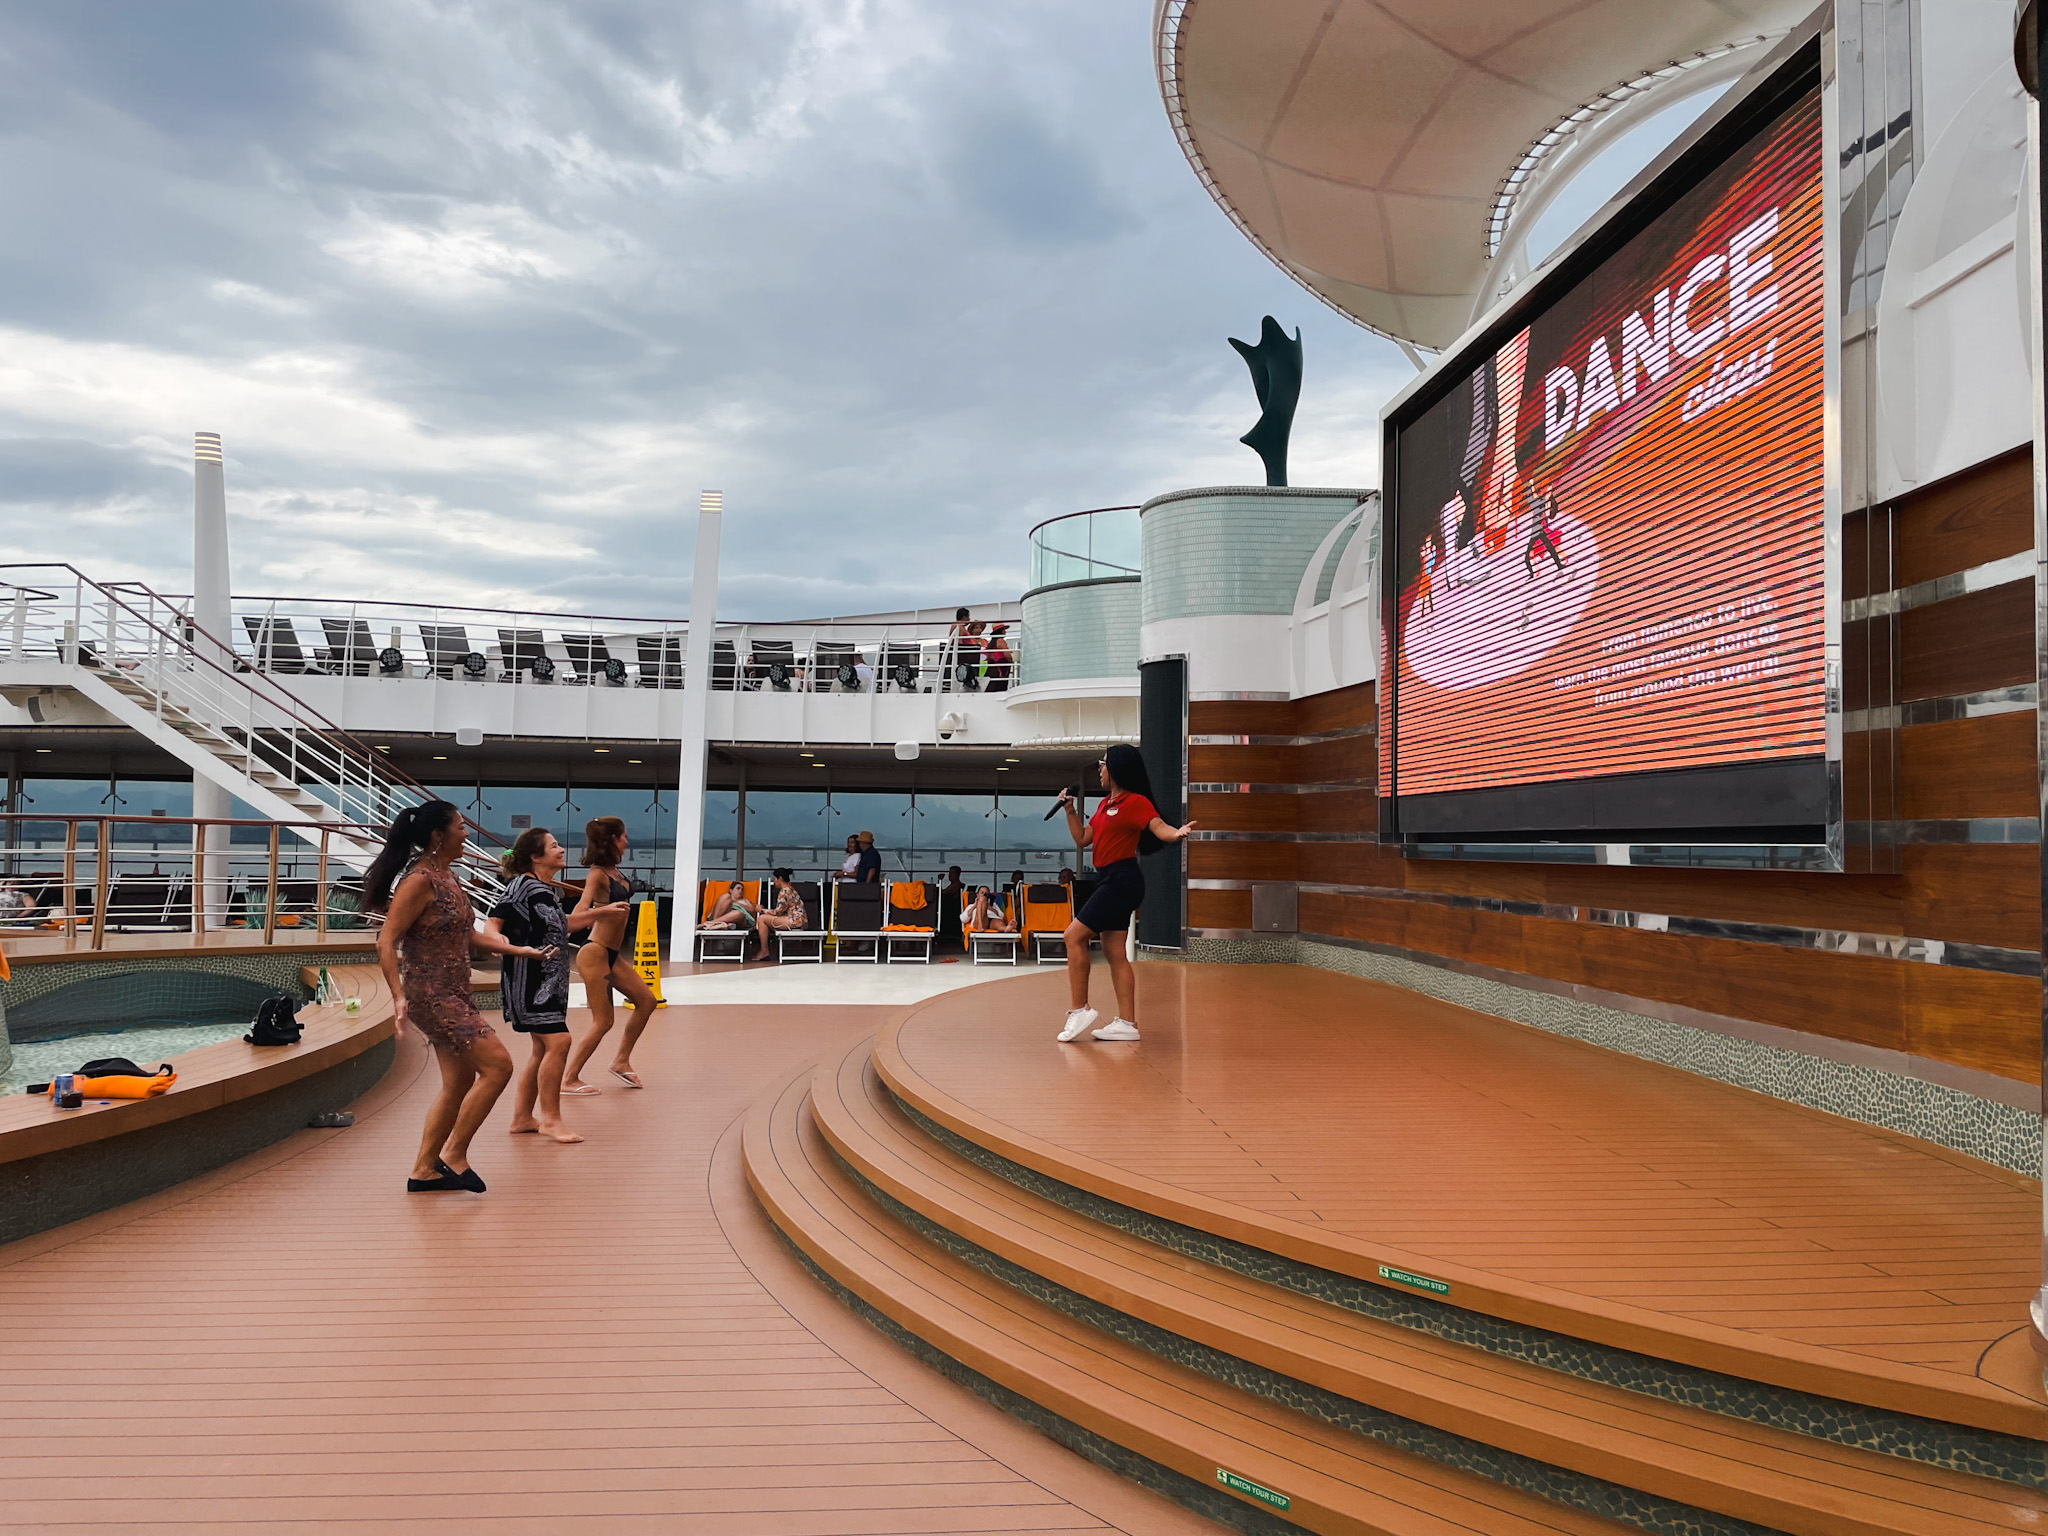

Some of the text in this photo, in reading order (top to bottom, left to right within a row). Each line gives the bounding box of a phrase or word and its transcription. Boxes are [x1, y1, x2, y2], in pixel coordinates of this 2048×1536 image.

[1544, 206, 1779, 451] DANCE
[1640, 611, 1713, 645] flamenco
[1717, 604, 1736, 623] to
[1554, 624, 1779, 691] learn the most famous dances
[1595, 689, 1628, 708] from
[1630, 671, 1684, 702] around
[1687, 668, 1716, 690] the
[1391, 1272, 1447, 1291] WATCH YOUR STEP
[1229, 1477, 1287, 1506] WATCH YOUR STEP
